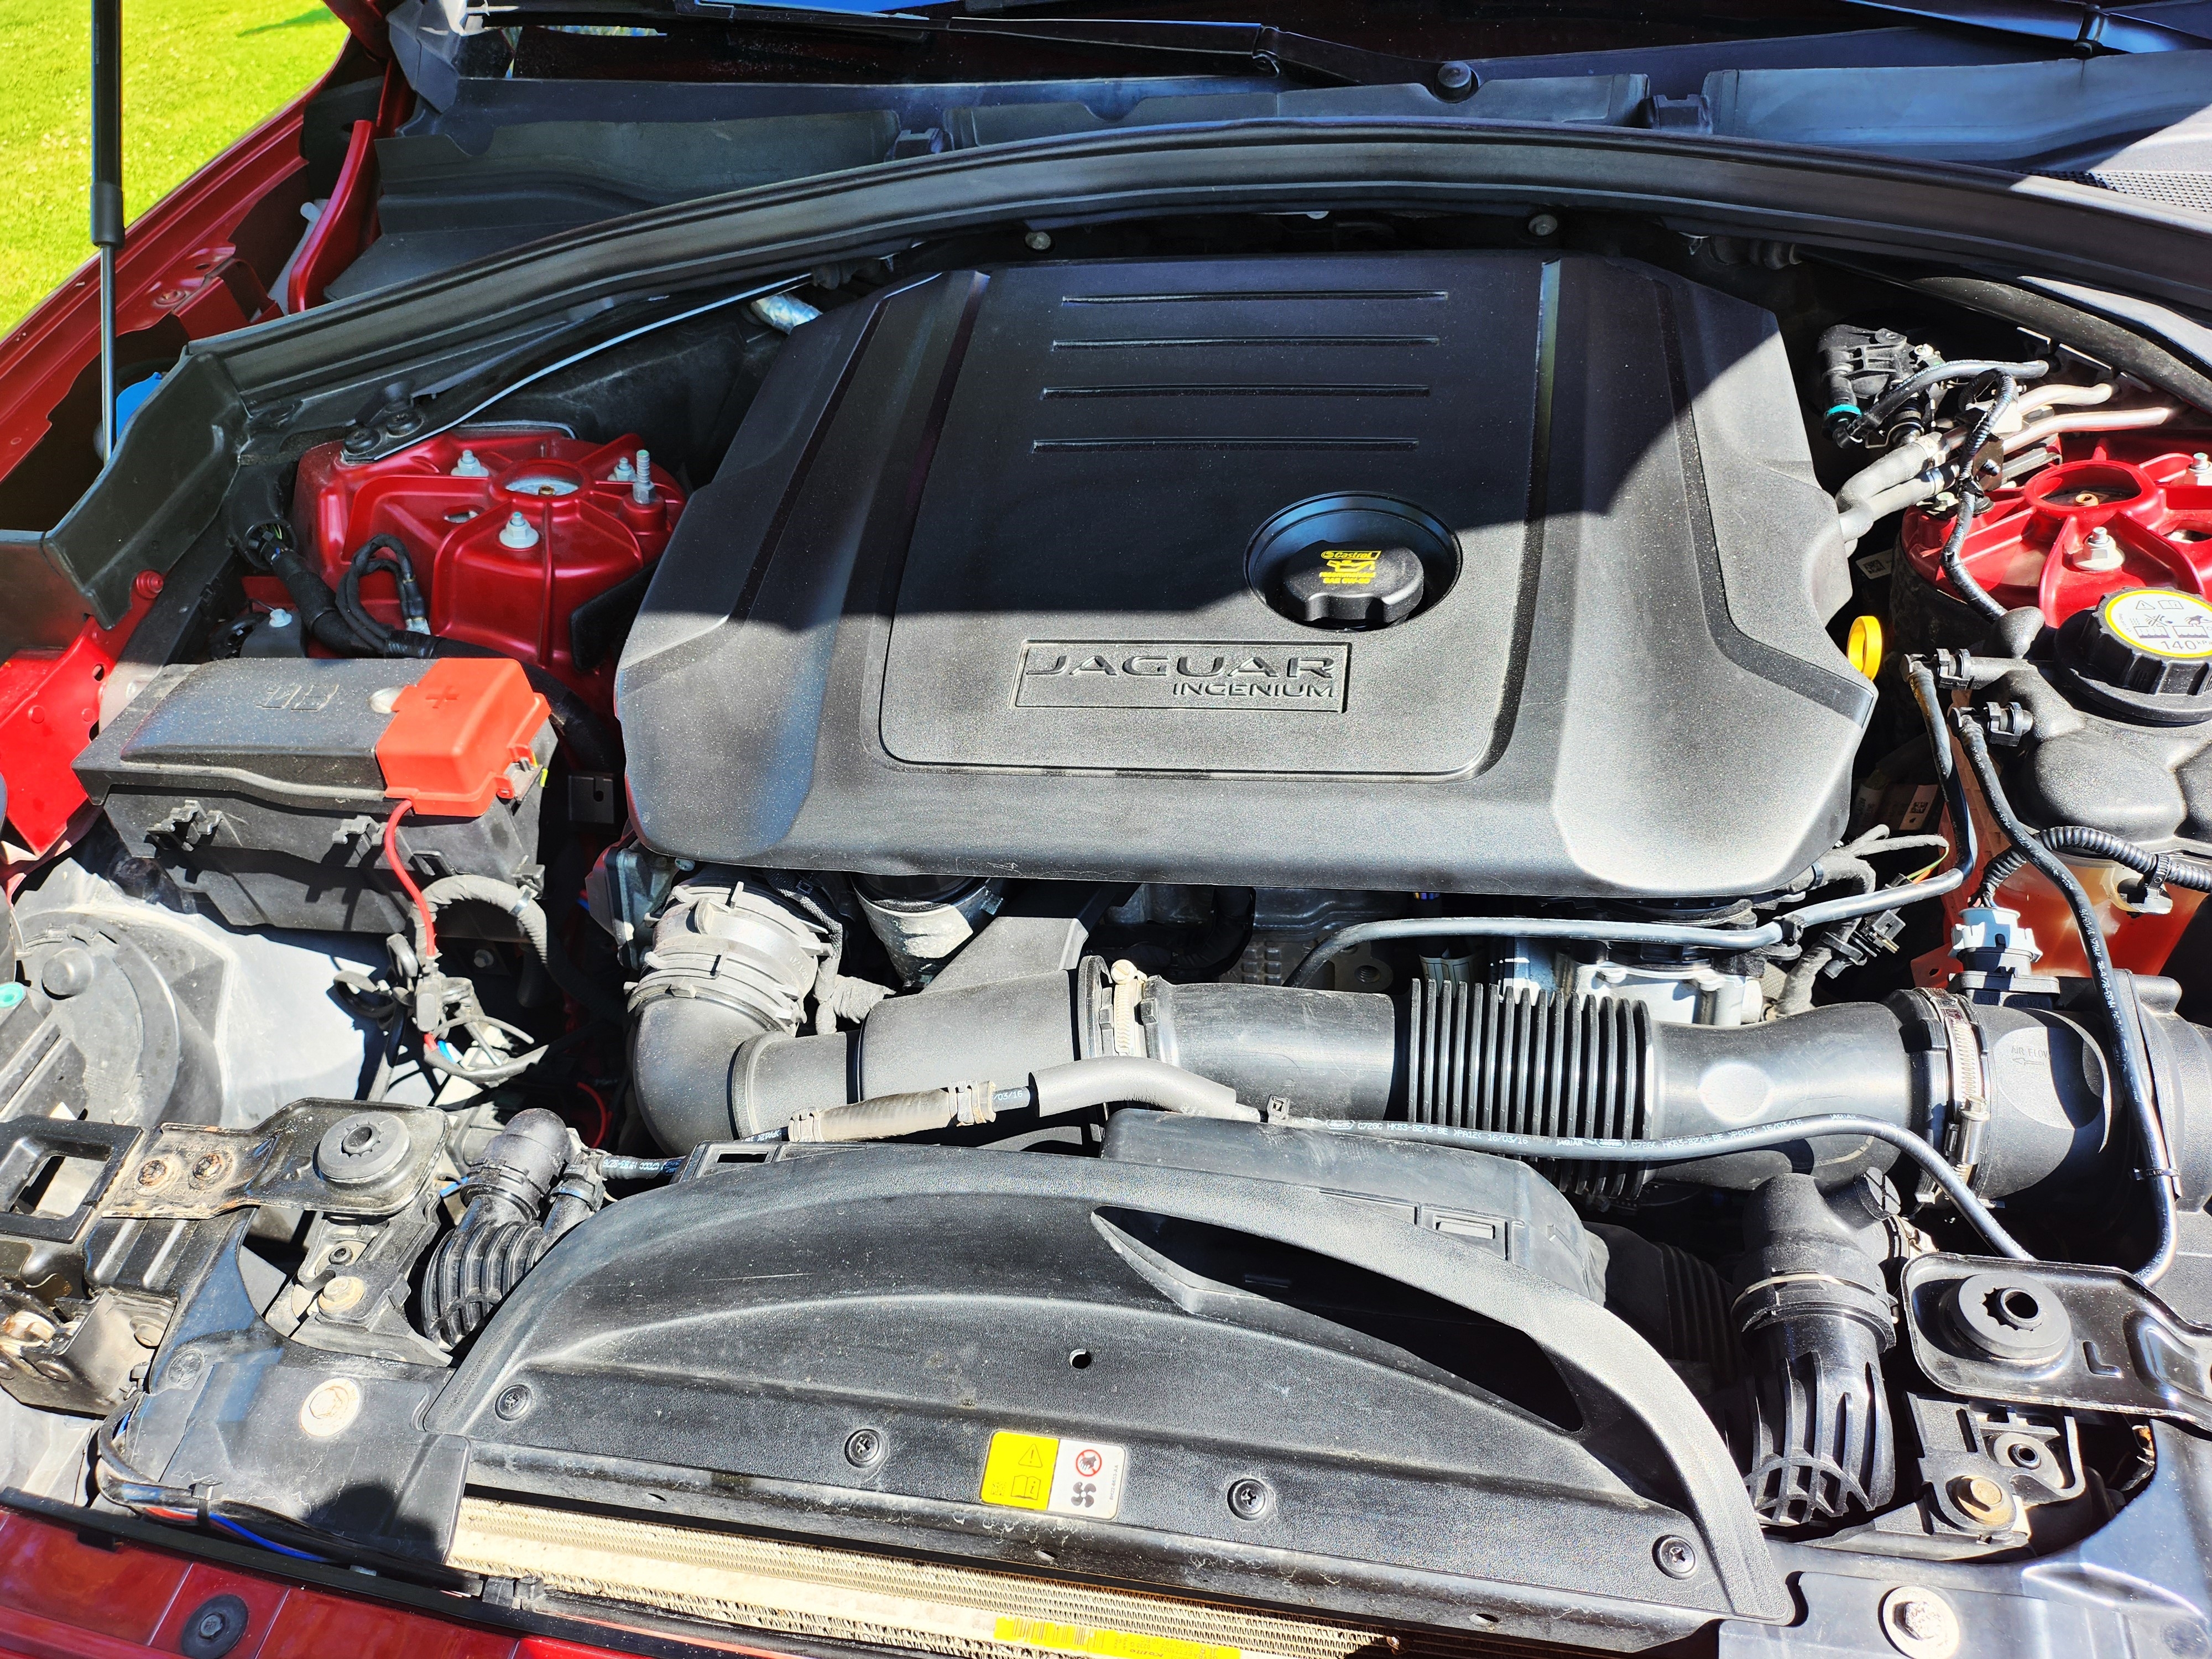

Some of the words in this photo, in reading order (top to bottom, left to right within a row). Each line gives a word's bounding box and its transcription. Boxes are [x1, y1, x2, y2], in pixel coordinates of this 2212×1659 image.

[2161, 640, 2197, 650] 140
[1026, 655, 1334, 679] JAGUAR
[1172, 681, 1334, 698] INGENIUM
[2011, 1045, 2026, 1056] AIR
[1762, 1118, 1803, 1133] 16/03/16
[1487, 1134, 1528, 1145] 16/03/16
